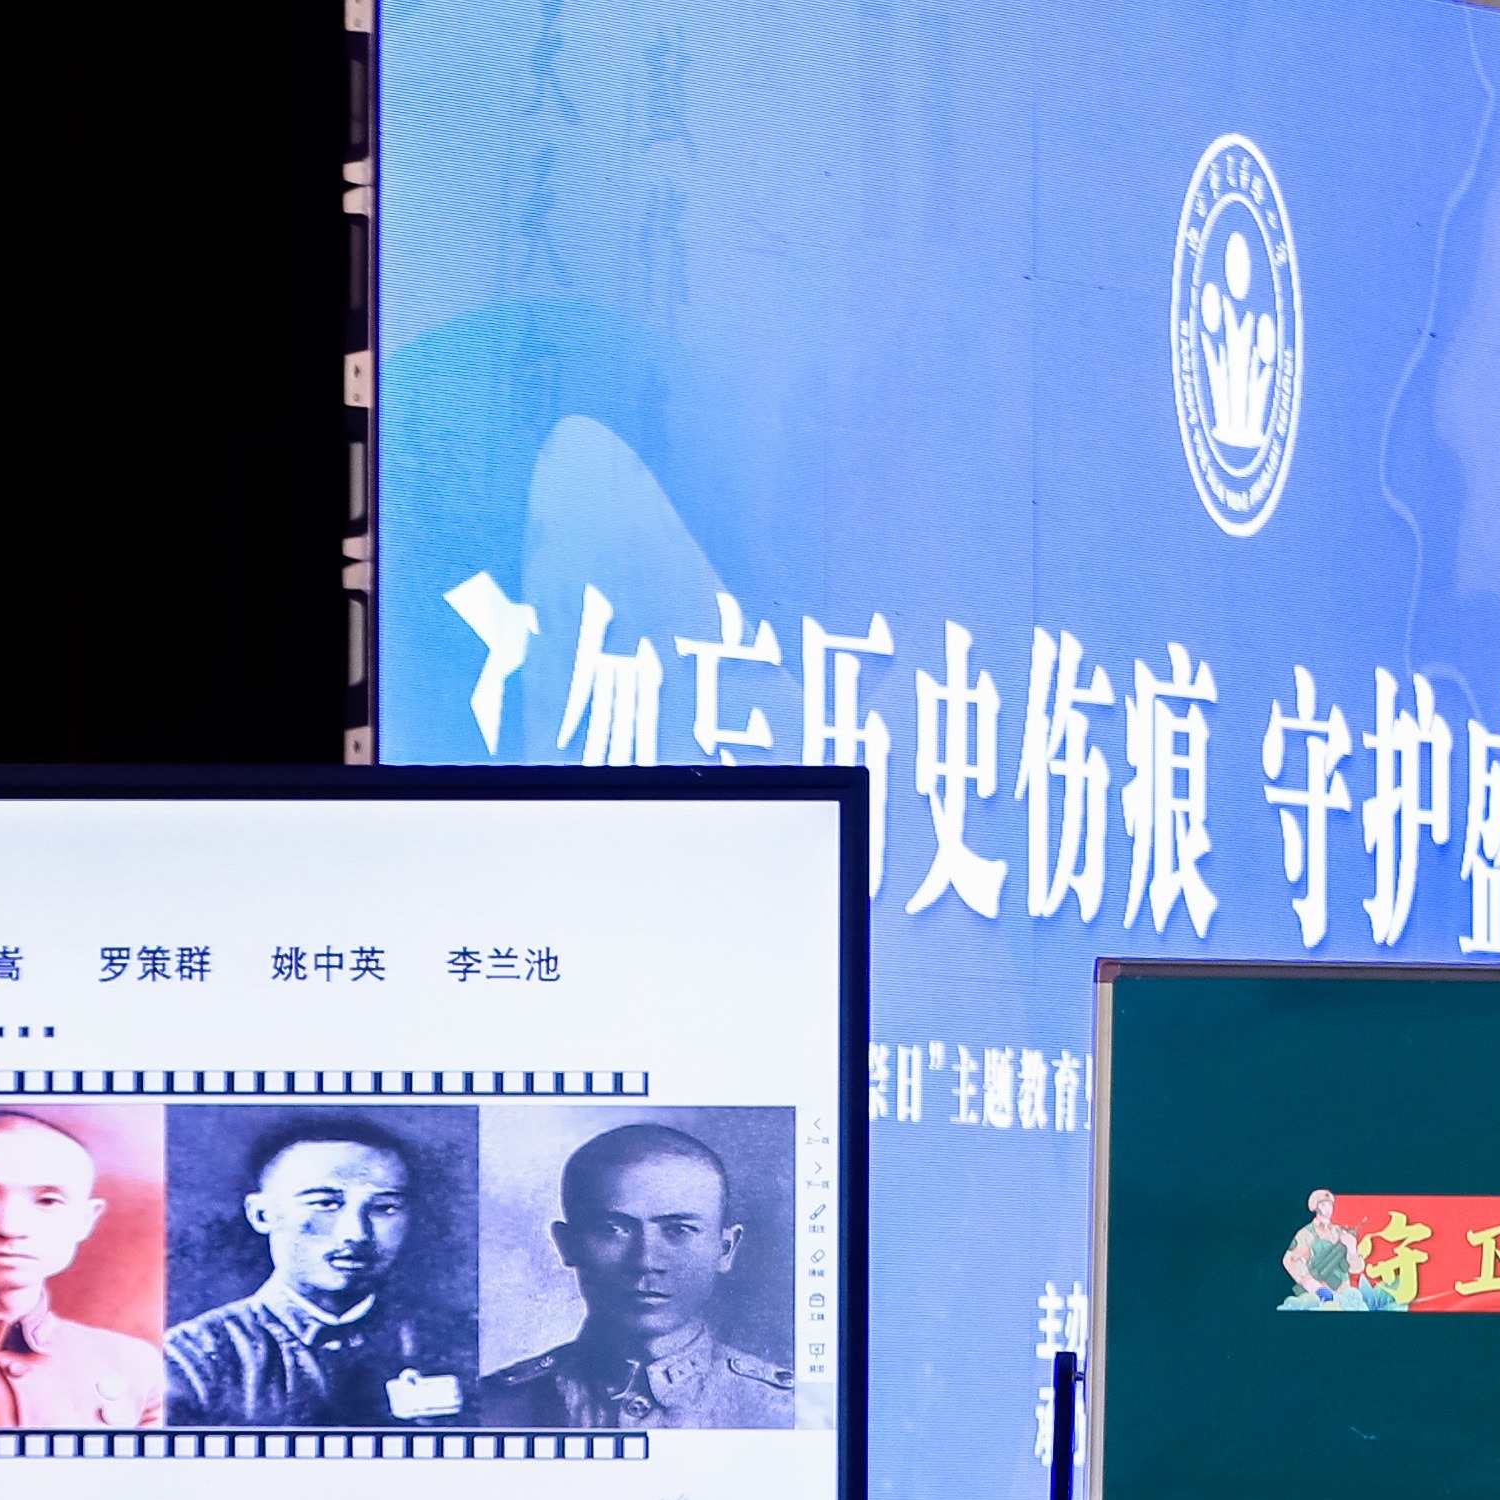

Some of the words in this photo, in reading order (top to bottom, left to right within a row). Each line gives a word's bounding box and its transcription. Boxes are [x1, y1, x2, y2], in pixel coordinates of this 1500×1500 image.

[98, 944, 212, 984] 罗策群
[270, 944, 386, 984] 姚中英
[446, 945, 561, 984] 李兰池
